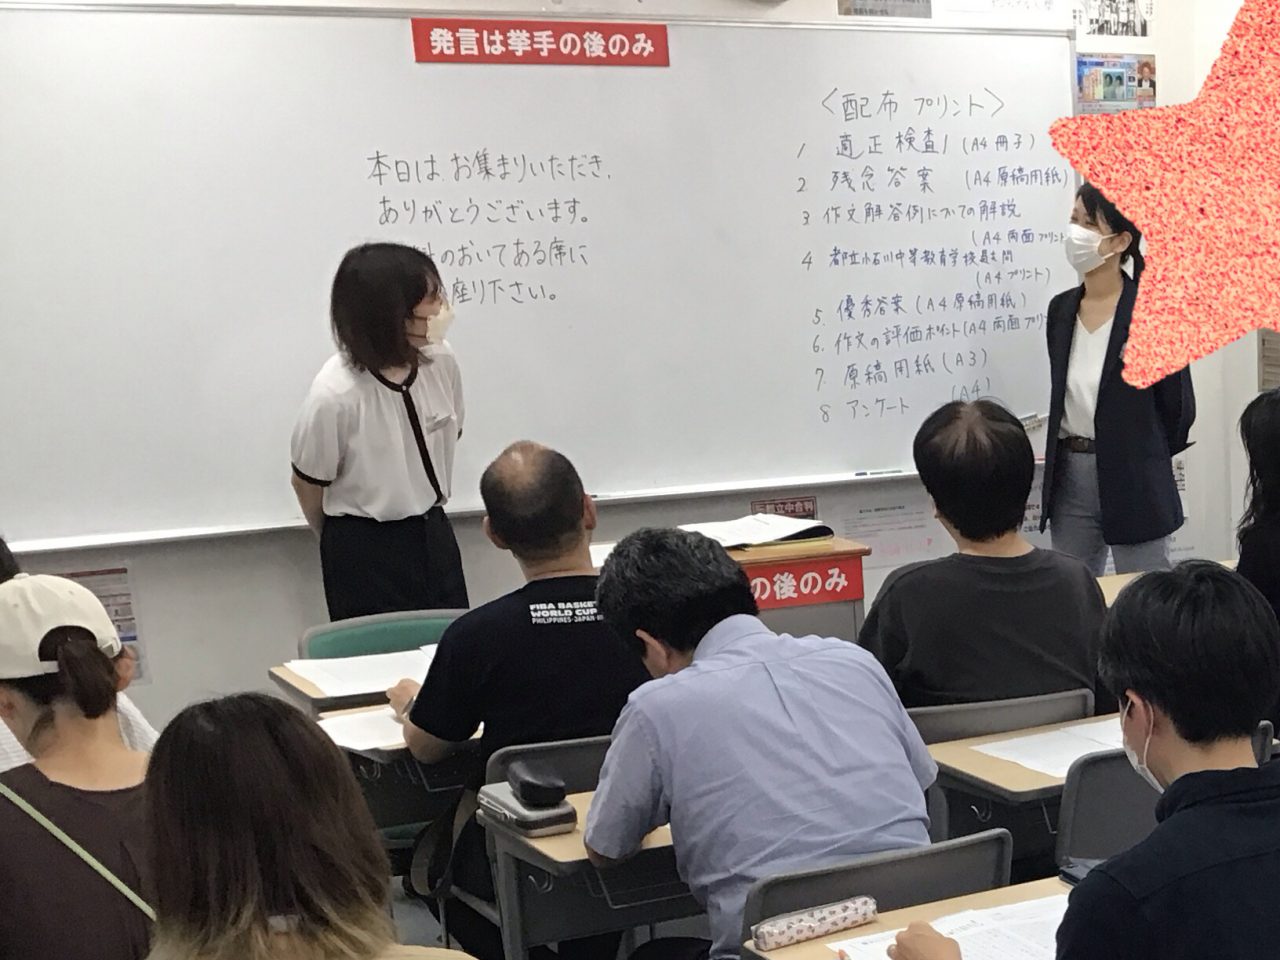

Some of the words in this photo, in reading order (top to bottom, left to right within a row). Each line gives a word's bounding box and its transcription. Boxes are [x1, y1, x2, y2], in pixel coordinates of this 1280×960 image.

[429, 28, 655, 58] 発言は挙手の後のみ
[378, 195, 589, 226] ありがとうございます。
[846, 396, 910, 422] アンケート
[529, 602, 556, 611] FIBA
[530, 609, 573, 618] WORLD
[574, 608, 598, 616] CUP
